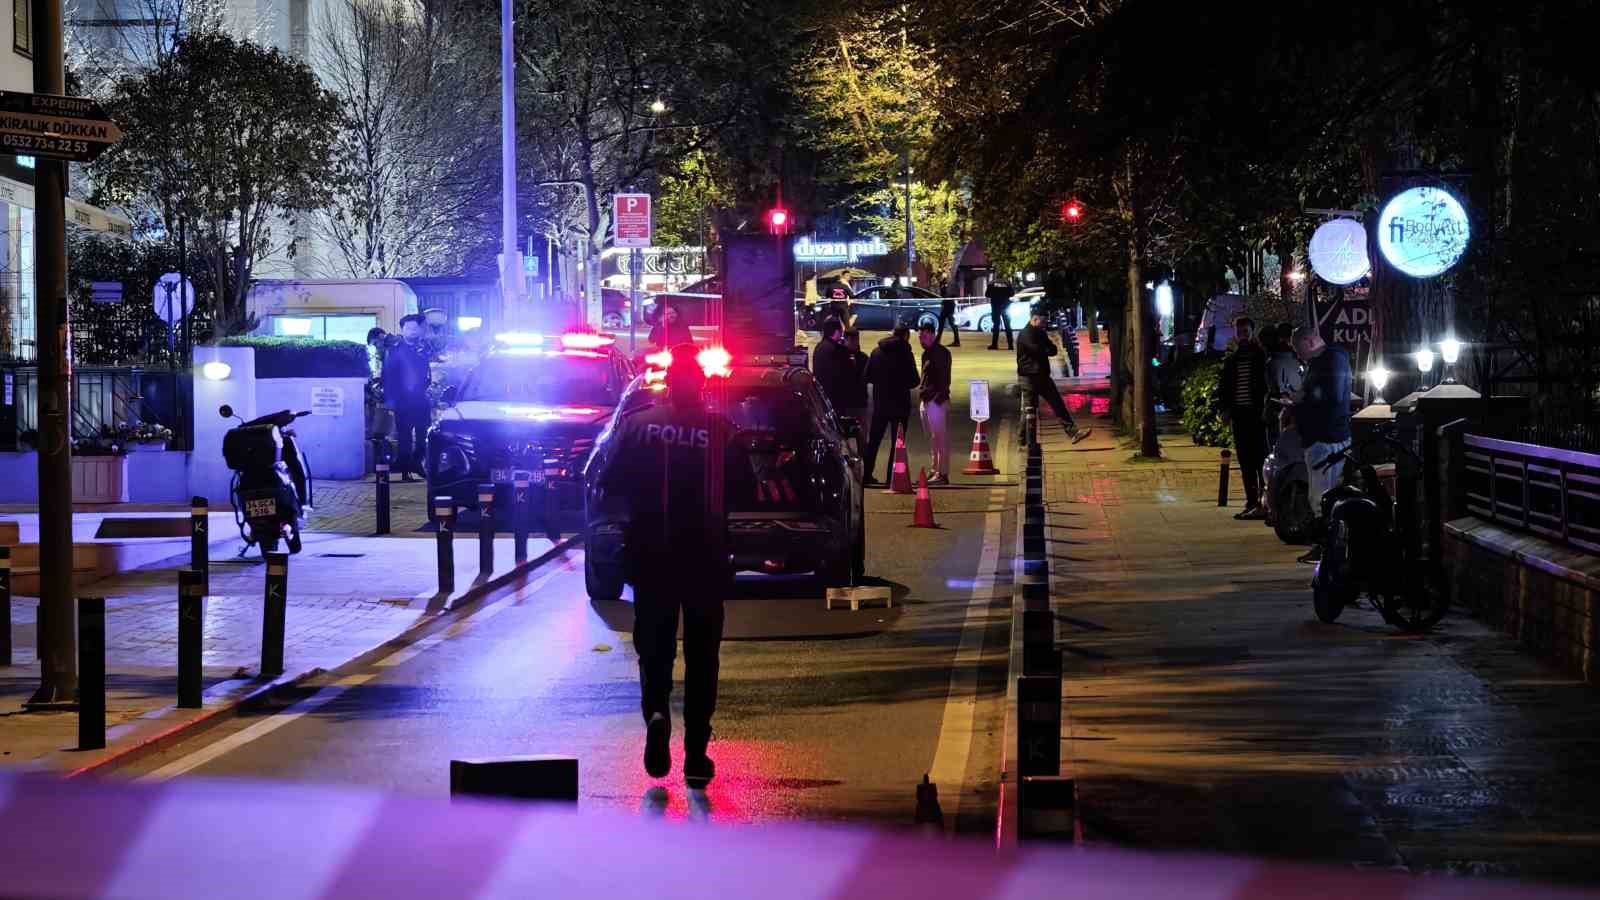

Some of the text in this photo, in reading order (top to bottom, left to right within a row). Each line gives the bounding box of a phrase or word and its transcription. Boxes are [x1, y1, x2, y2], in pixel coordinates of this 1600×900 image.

[53, 120, 107, 138] DÜKKAN
[3, 134, 32, 148] 0532
[57, 140, 72, 152] 22
[627, 198, 638, 213] P
[848, 236, 888, 263] pub
